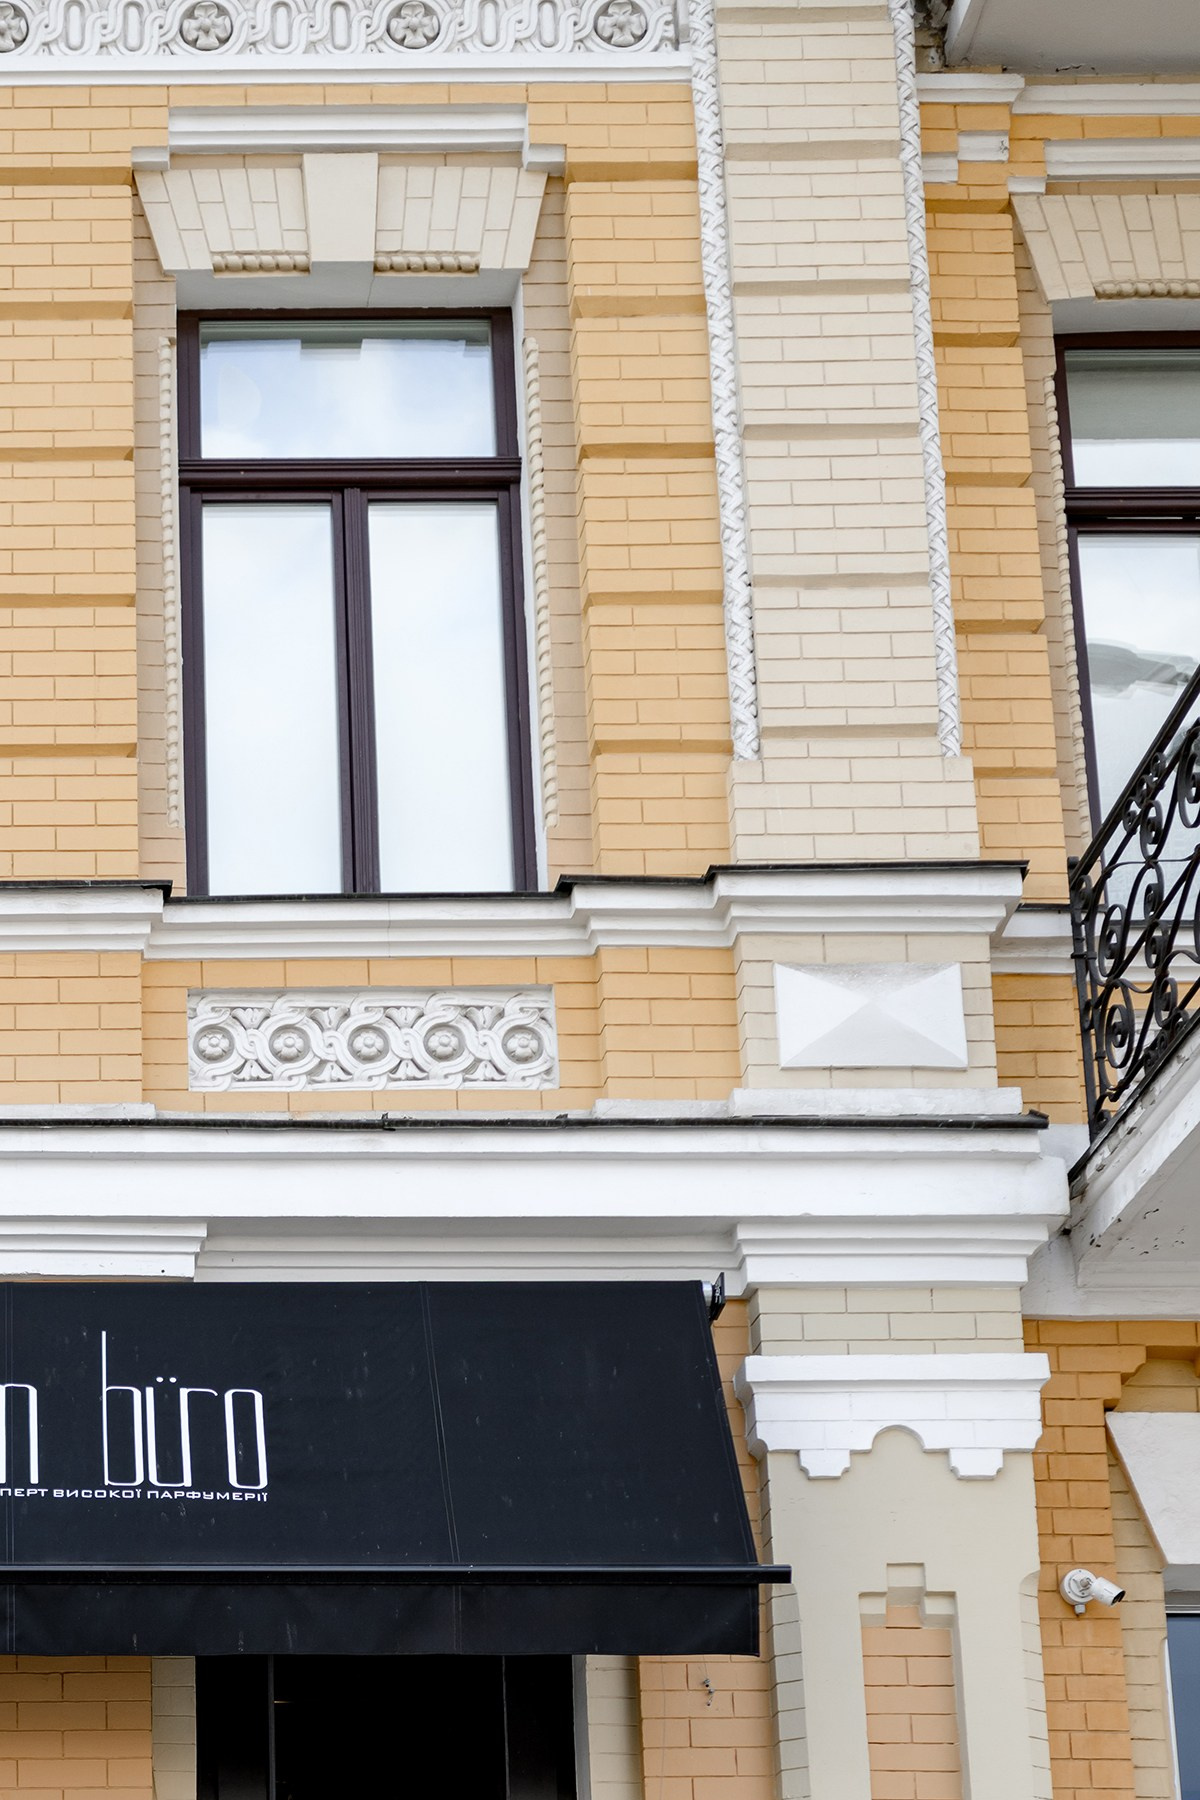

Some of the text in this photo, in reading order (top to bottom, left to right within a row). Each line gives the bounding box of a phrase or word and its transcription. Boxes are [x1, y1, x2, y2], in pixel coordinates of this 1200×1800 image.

[102, 1331, 268, 1490] büro
[53, 1488, 142, 1499] ВИСОКОЇ
[147, 1490, 268, 1502] ПАРФУМЕРІЇ
